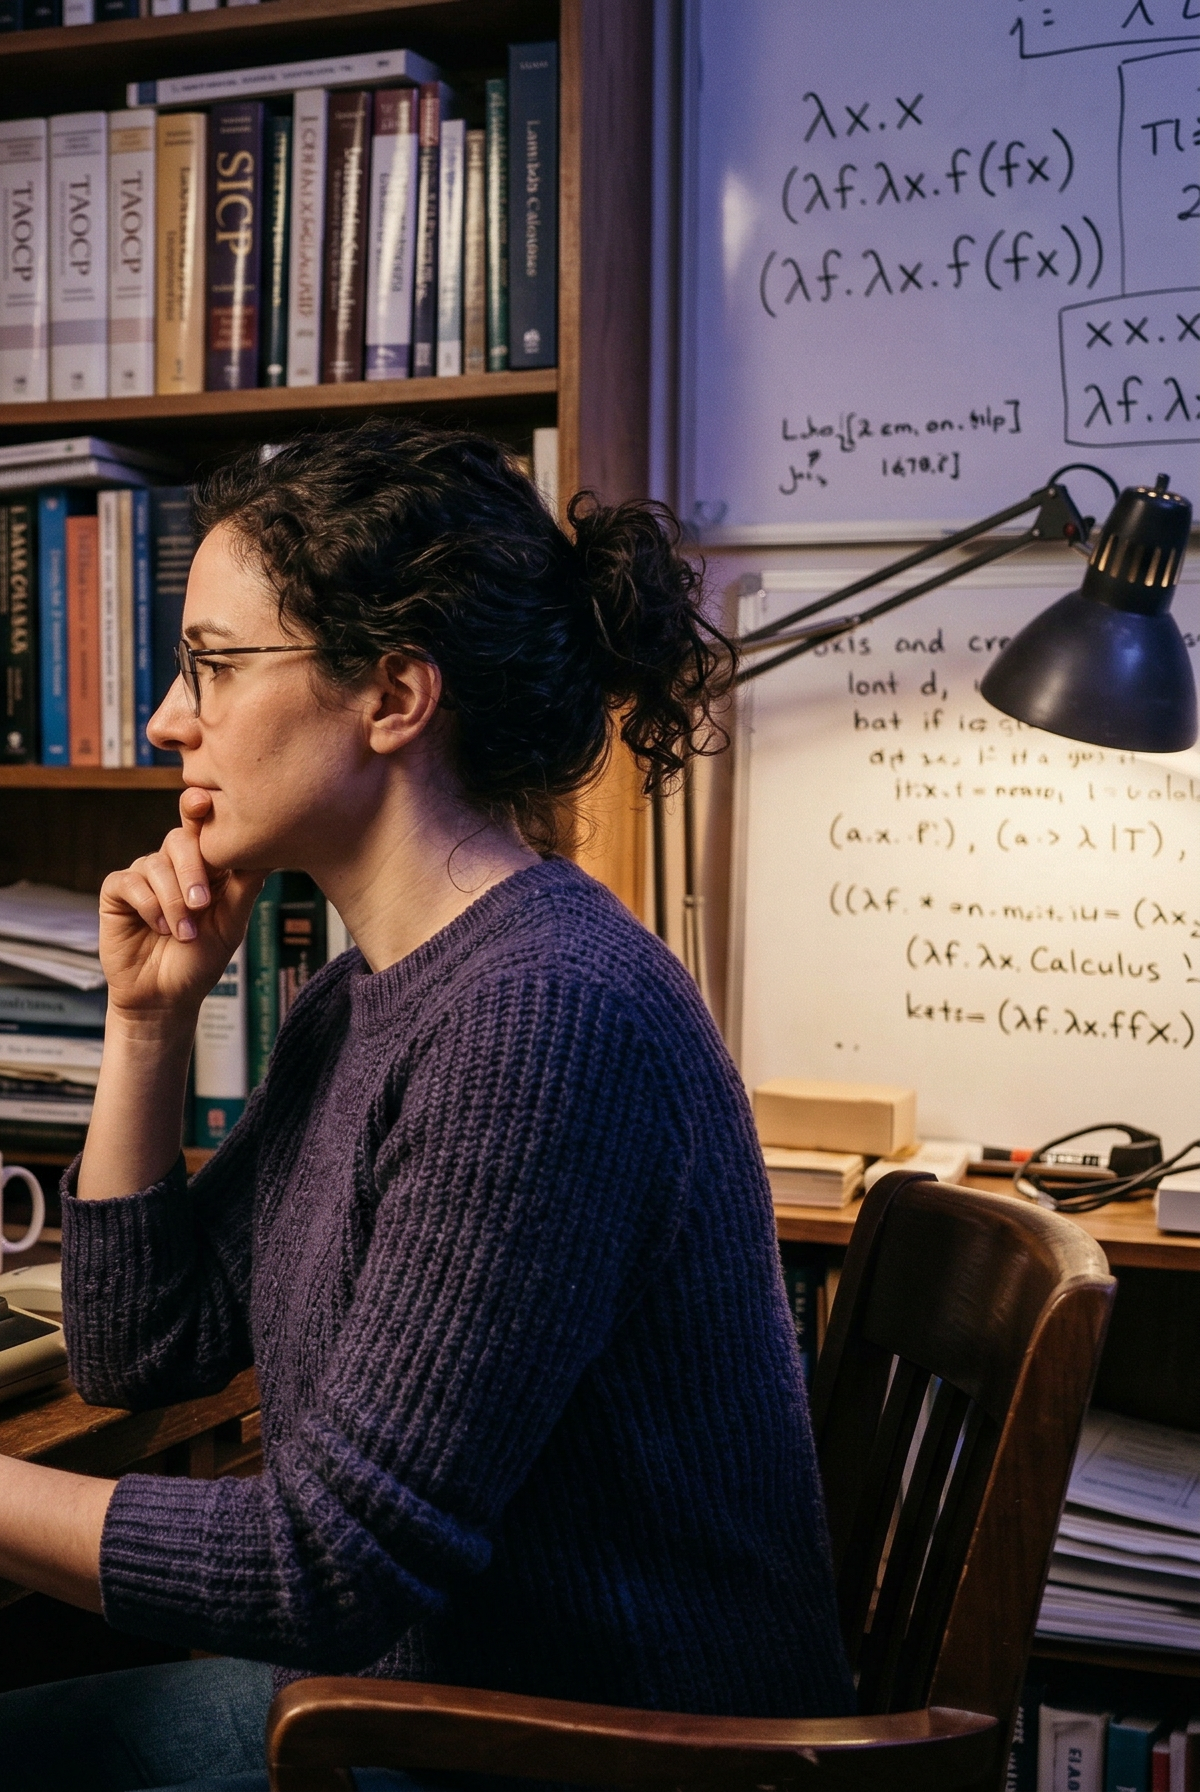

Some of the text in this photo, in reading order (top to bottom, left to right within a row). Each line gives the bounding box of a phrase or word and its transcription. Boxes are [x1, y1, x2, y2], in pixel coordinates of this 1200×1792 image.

[10, 181, 34, 282] TAOCP
[68, 174, 91, 276] TAOCP
[120, 170, 142, 274] TAOCP
[215, 150, 254, 257] SICP
[895, 627, 945, 653] and
[1030, 945, 1162, 983] Calculus
